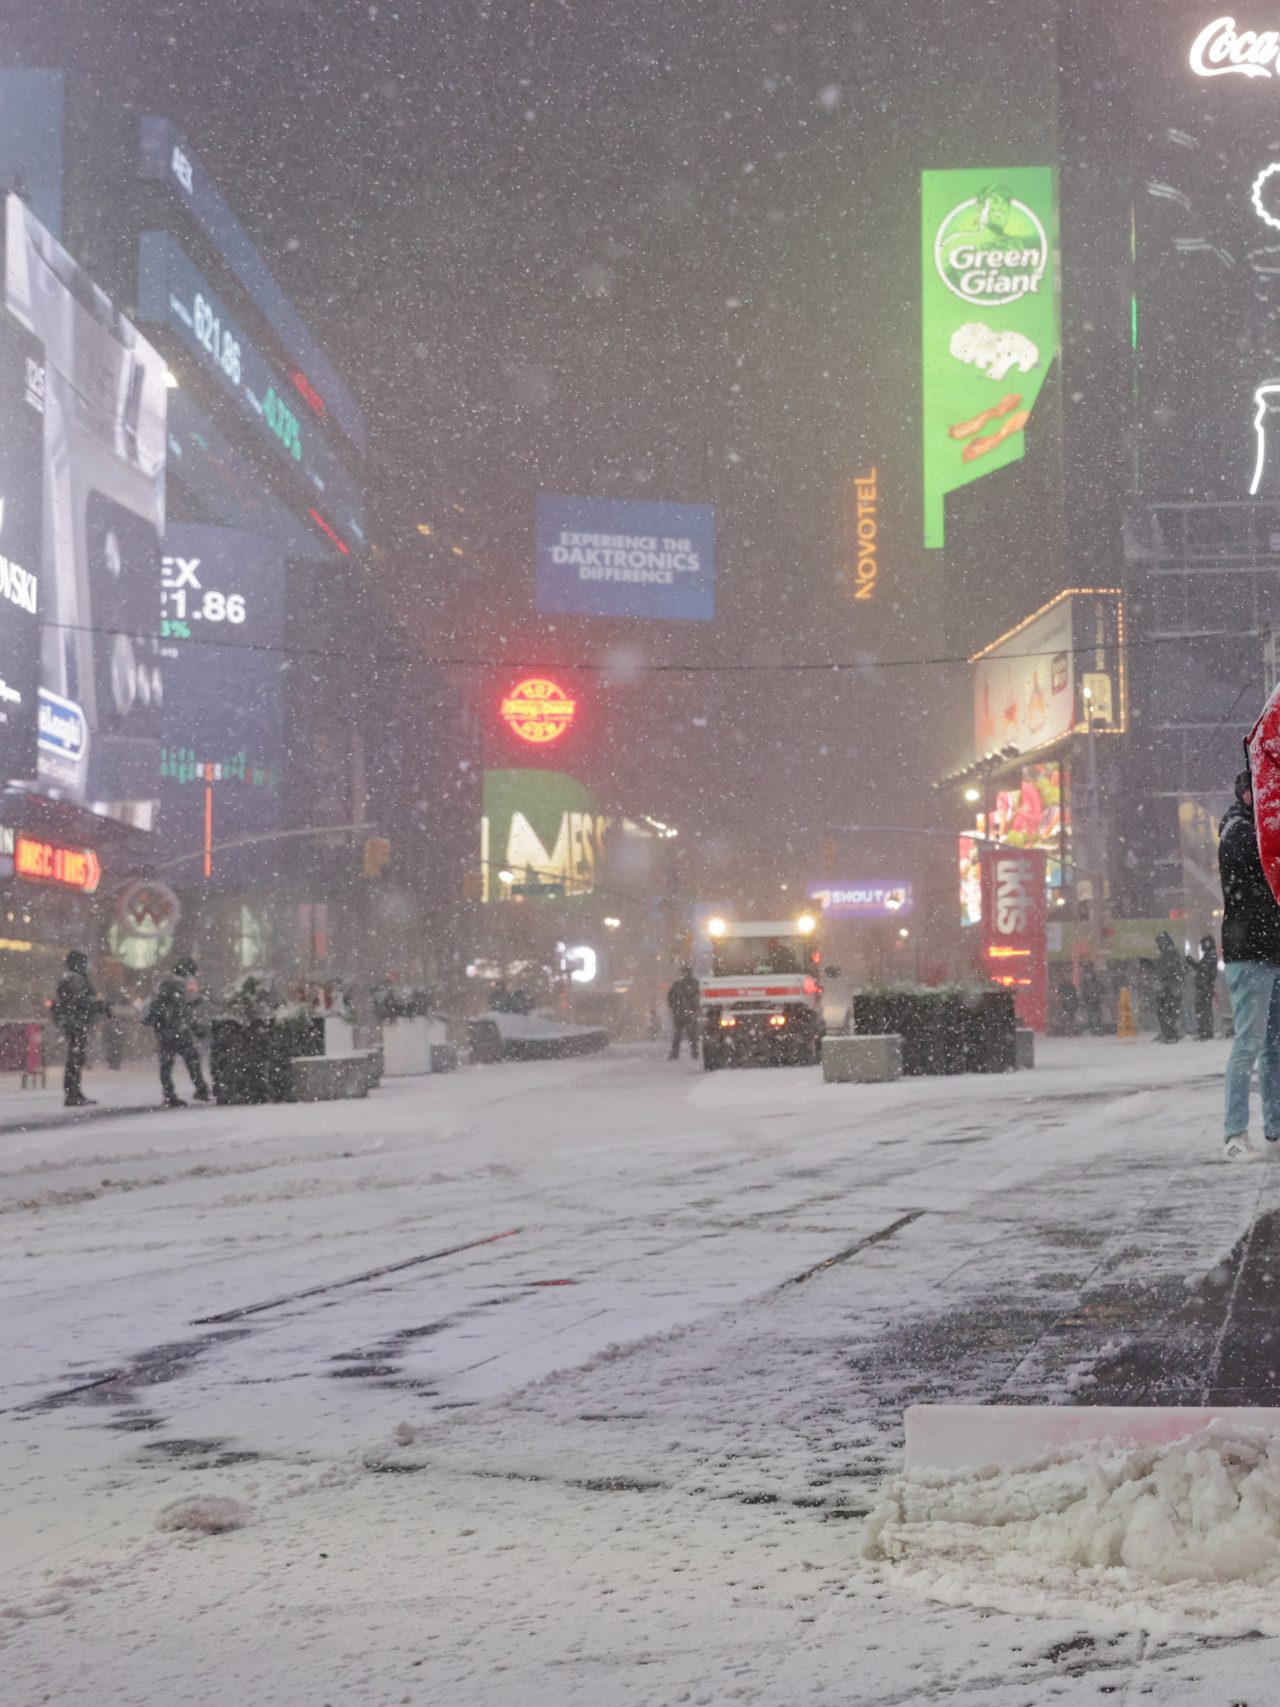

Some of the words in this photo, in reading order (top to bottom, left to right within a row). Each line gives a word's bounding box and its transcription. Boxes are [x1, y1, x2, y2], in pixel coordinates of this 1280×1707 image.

[949, 245, 1039, 270] Green
[960, 269, 1042, 295] Giant
[560, 531, 657, 550] EXPERIENCE
[662, 537, 691, 553] THE
[854, 467, 876, 599] NOVOTEL
[552, 546, 700, 571] DAKTRONICS
[579, 567, 673, 584] DIFFERENCE
[832, 890, 883, 903] SHOUT
[997, 859, 1034, 935] tkts
